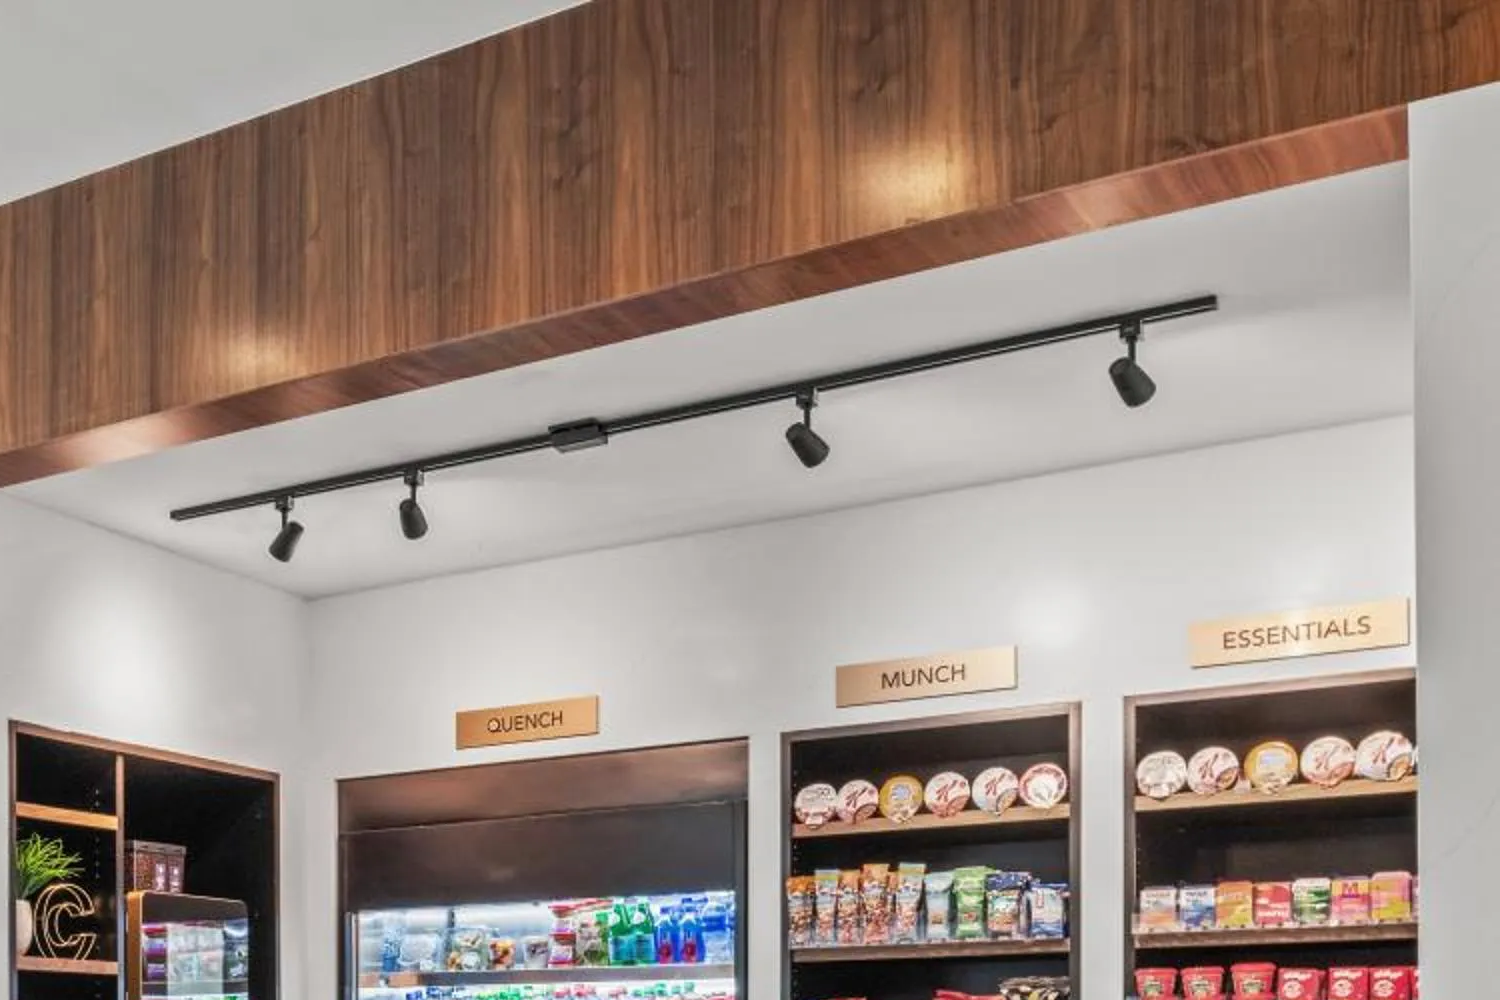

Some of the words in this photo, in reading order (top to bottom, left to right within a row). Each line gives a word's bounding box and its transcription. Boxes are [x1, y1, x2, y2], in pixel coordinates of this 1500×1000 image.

[1222, 615, 1372, 650] ESSENTIALS
[880, 664, 966, 690] MUNCH
[486, 710, 564, 733] QUENCH
